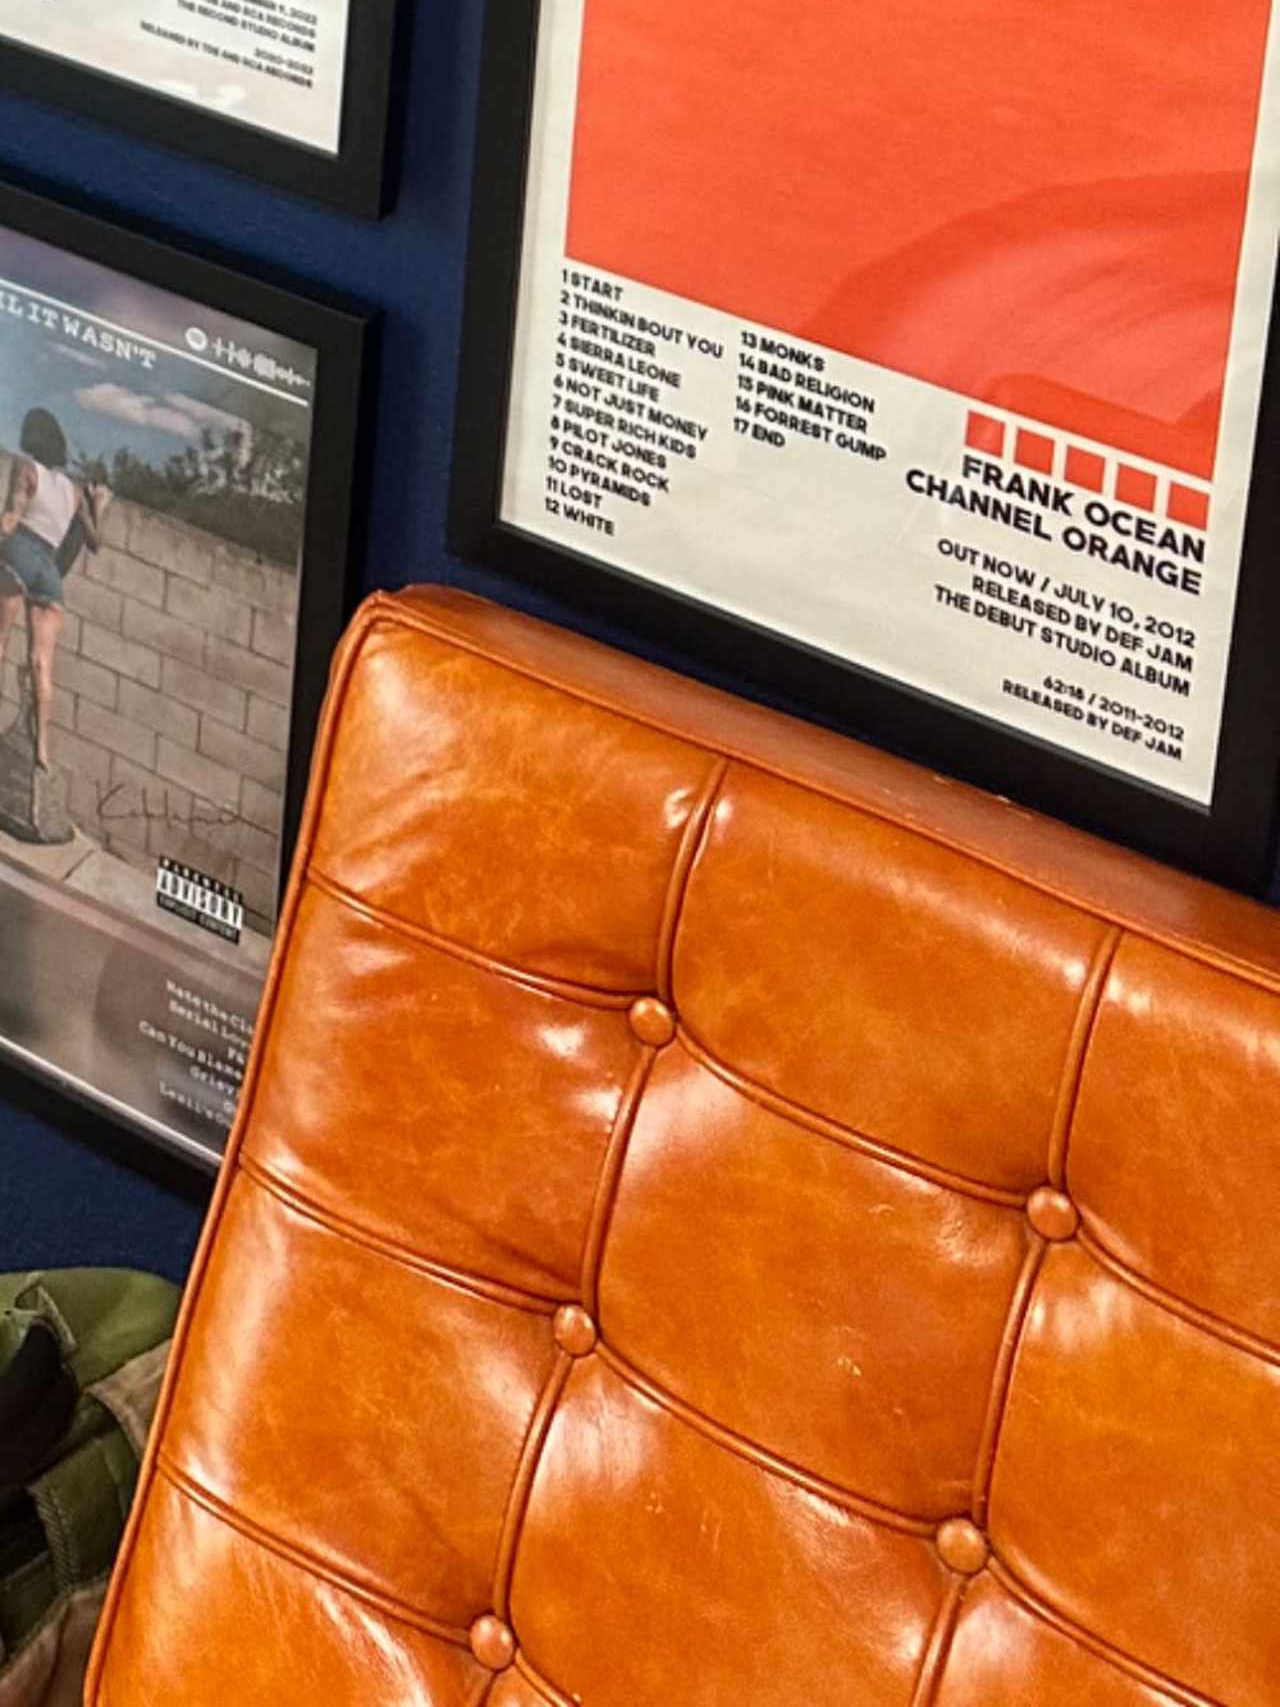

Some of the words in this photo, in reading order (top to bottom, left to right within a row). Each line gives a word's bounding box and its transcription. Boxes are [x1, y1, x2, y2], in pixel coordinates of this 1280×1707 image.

[570, 271, 623, 301] START
[27, 302, 59, 329] IT
[63, 317, 156, 368] WASN'T
[570, 314, 655, 357] FERTILIZER
[573, 293, 635, 328] THINKIN
[636, 316, 683, 344] BOUT
[686, 332, 723, 359] YOU
[740, 330, 757, 349] 13
[758, 336, 825, 372] MONKS
[567, 356, 626, 388] SWEET
[626, 377, 659, 403] LIFE
[569, 335, 625, 368] SIERRA
[627, 356, 680, 389] LEONE
[738, 352, 755, 371] 14
[756, 358, 792, 383] BAD
[794, 371, 875, 413] RELIGION
[563, 398, 615, 429] SUPER
[616, 417, 656, 444] RICH
[657, 433, 696, 459] KIDS
[565, 377, 601, 402] NOT
[602, 392, 645, 418] JUST
[647, 406, 708, 441] MONEY
[732, 416, 750, 434] 17
[750, 423, 785, 447] END
[735, 395, 752, 413] 16
[753, 401, 833, 443] FORREST
[834, 432, 887, 461] GUMP
[737, 373, 754, 392] 15
[755, 380, 794, 407] PINK
[797, 395, 867, 434] MATTER
[560, 440, 618, 473] CRACK
[620, 461, 669, 493] ROCK
[562, 418, 609, 448] PILOT
[610, 438, 667, 470] JONES
[545, 475, 558, 493] 11
[559, 480, 603, 509] LOST
[547, 454, 567, 474] 10
[568, 462, 650, 507] PYRAMIDS
[961, 454, 1074, 517] FRANK
[1083, 500, 1205, 563] OCEAN
[544, 496, 560, 515] 12
[562, 503, 614, 536] WHITE
[905, 468, 1052, 542] CHANNEL
[1061, 525, 1202, 596] ORANGE
[936, 537, 980, 566] OUT
[981, 553, 1036, 587] NOW
[1053, 583, 1105, 613] JULY
[1109, 601, 1140, 630] 10,
[1143, 615, 1195, 649] 2012
[971, 574, 1071, 625] RELEASED
[1073, 613, 1102, 636] BY
[1104, 624, 1143, 651] DEF
[1145, 643, 1193, 673] JAM
[934, 583, 970, 613] THE
[972, 599, 1037, 637] DEBUT
[1039, 625, 1116, 667] STUDIO
[1119, 656, 1190, 697] ALBUM
[1002, 678, 1084, 721] RELEASED
[1085, 711, 1108, 730] BY
[1110, 721, 1142, 743] DEF
[1144, 737, 1182, 761] JAM
[1098, 695, 1184, 742] 2011-2012
